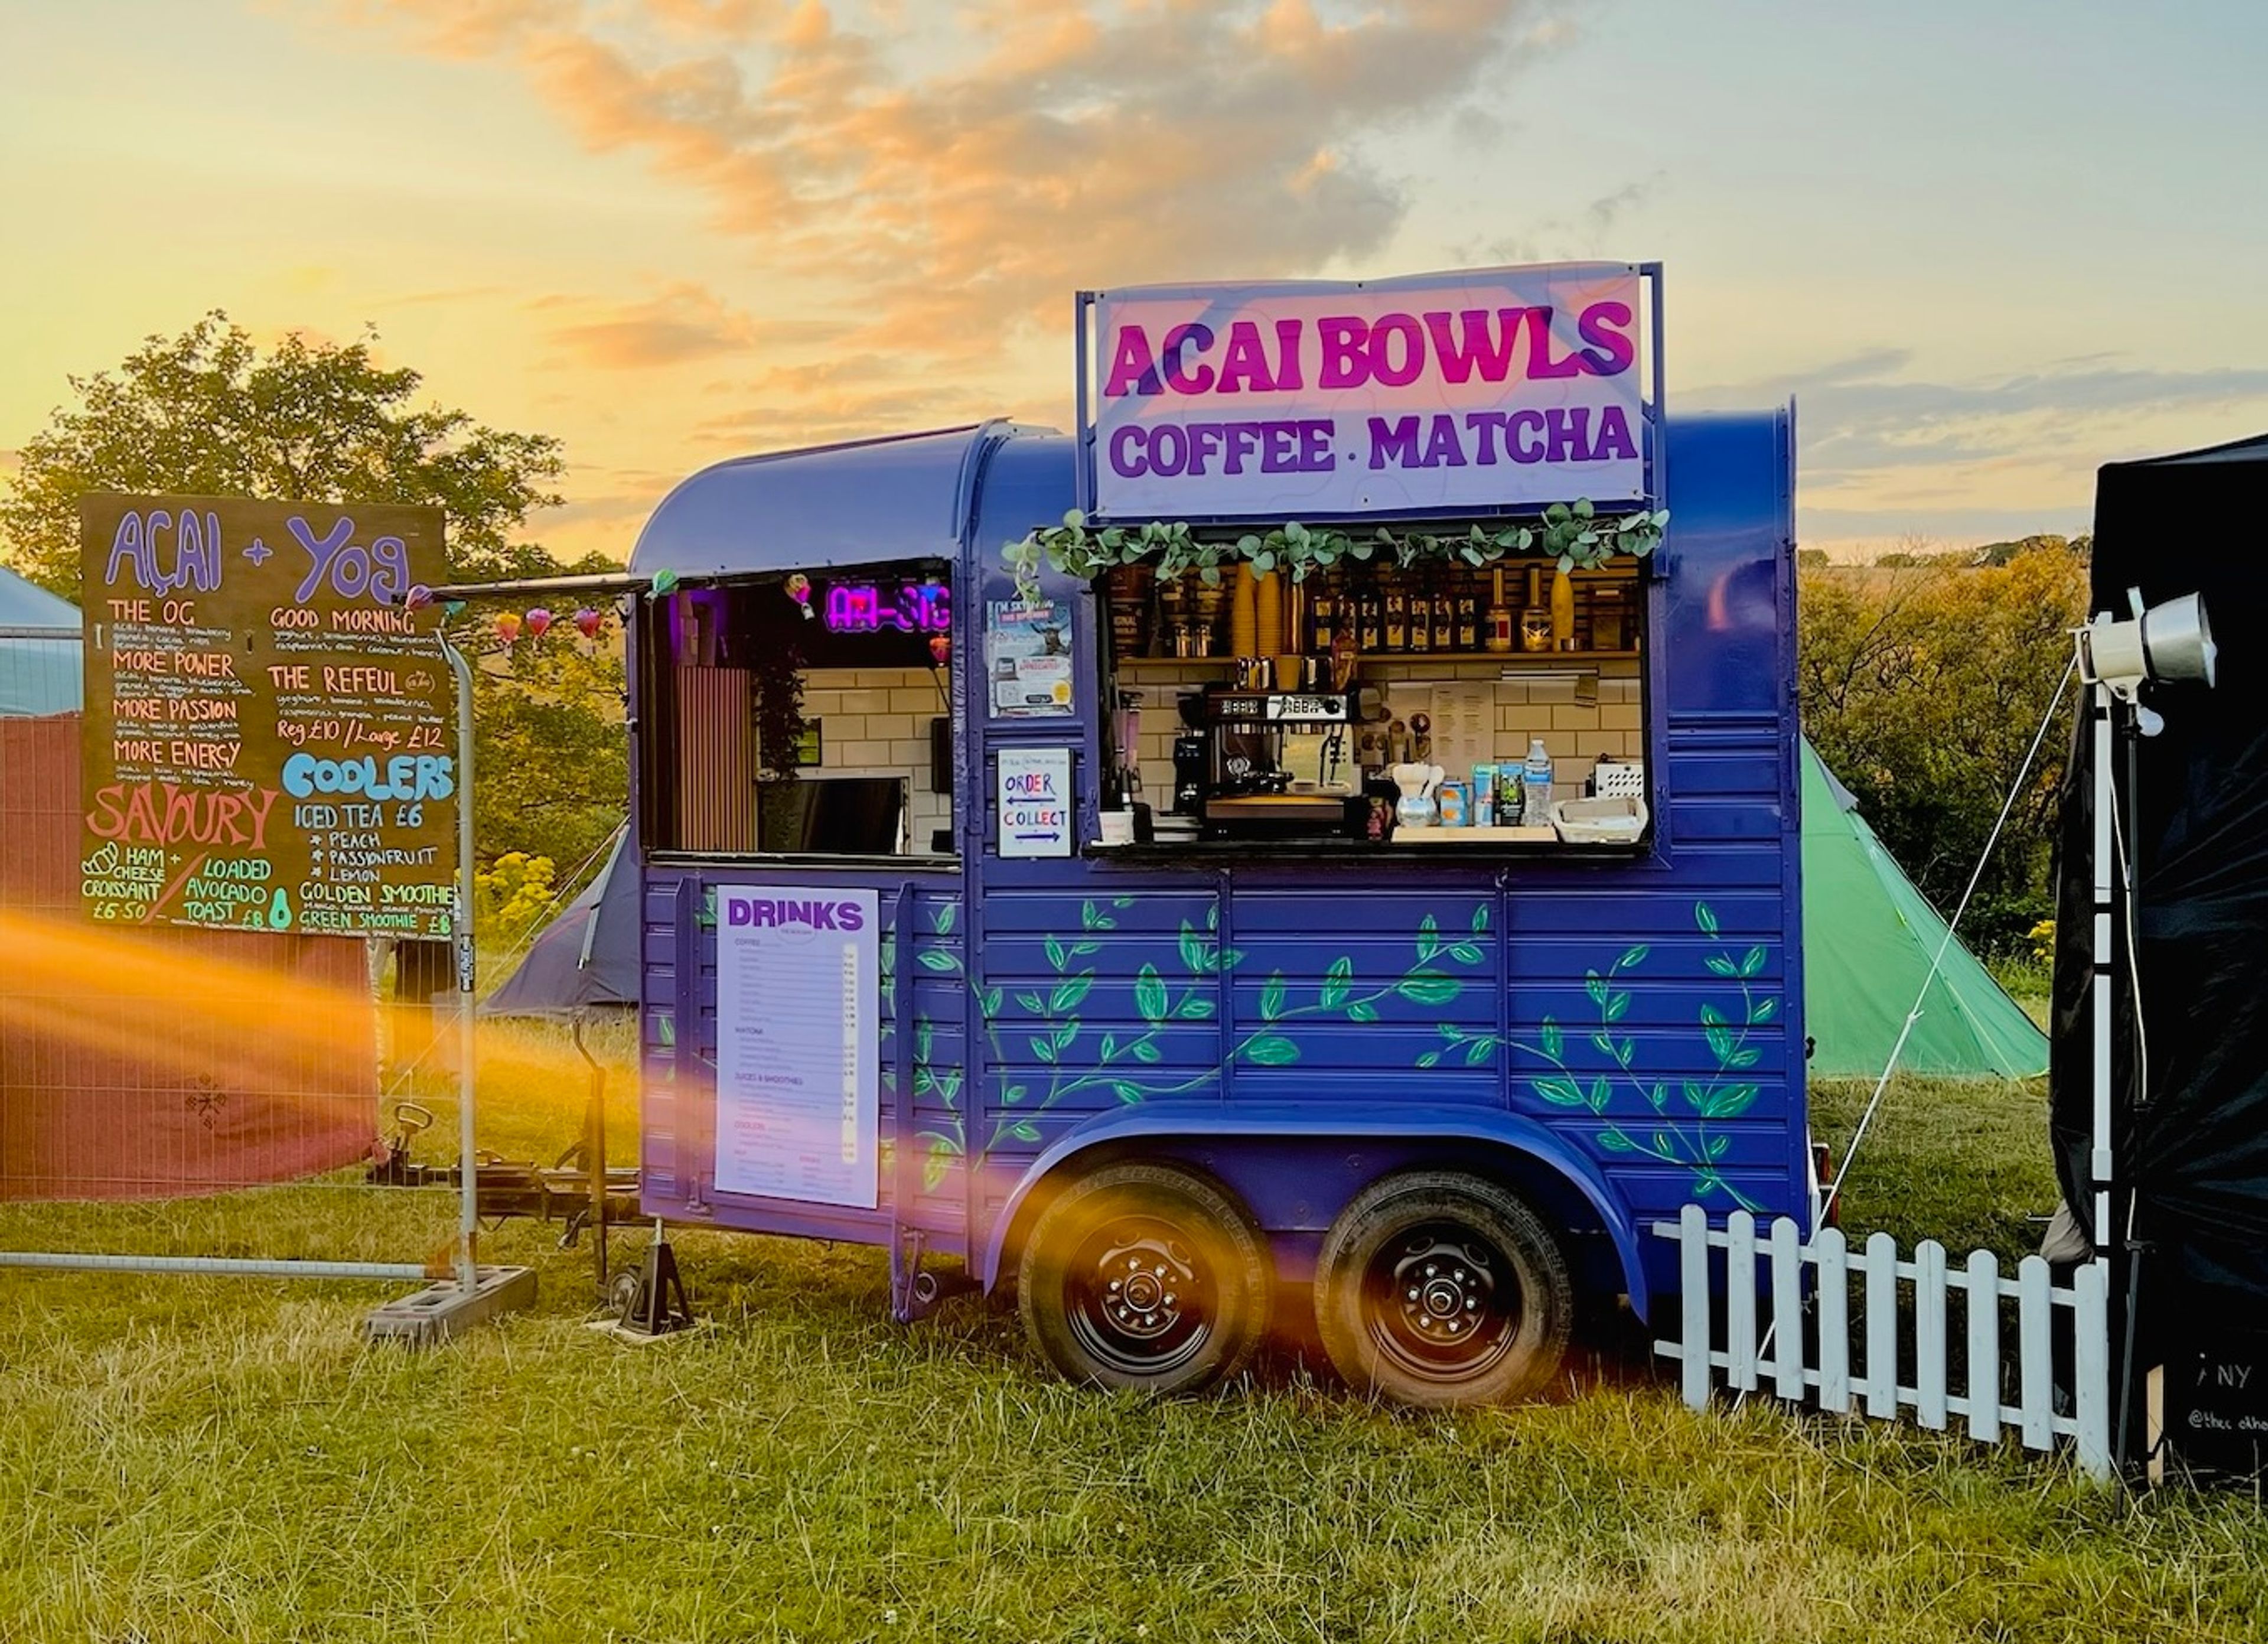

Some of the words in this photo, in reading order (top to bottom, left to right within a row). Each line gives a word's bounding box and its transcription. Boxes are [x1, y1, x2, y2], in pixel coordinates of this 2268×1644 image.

[1104, 320, 1303, 396] ACAI
[1318, 302, 1634, 389] BOWLS
[1109, 420, 1335, 478] COFFEE
[1368, 406, 1638, 470] MATCHA
[107, 599, 151, 621] THE
[163, 600, 195, 625] OG
[270, 607, 320, 629] GOOD
[331, 610, 415, 634] MORNING
[113, 651, 168, 673] MORE
[175, 653, 235, 677] POWER
[267, 666, 310, 689] THE
[323, 666, 405, 695] REFEUL
[113, 699, 162, 720] MORE
[168, 699, 237, 721] PASSION
[278, 720, 306, 746] Reg
[308, 720, 340, 740] £10
[406, 725, 445, 749] £12
[113, 741, 164, 763] MORE
[171, 741, 242, 769] ENERGY
[282, 752, 455, 800] COOLERS
[1005, 773, 1057, 795] ORDER
[86, 782, 279, 851] SAVOURY
[295, 804, 338, 829] ICED
[341, 804, 384, 828] TEA
[395, 803, 423, 828] £6
[1004, 810, 1067, 826] COLLECT
[329, 831, 382, 848] PEACH
[126, 847, 165, 867] HAM
[203, 858, 272, 880] LOADED
[329, 847, 438, 866] PASSIONFRUIT
[112, 865, 166, 883] CHEESE
[330, 868, 380, 883] LEMON
[82, 880, 162, 902] CROISSANT
[185, 878, 268, 904] AVOCADO
[299, 881, 372, 904] GOLDEN
[379, 885, 454, 905] SMOOTHIE
[183, 901, 237, 922] TOAST
[242, 910, 265, 928] £8
[299, 910, 352, 929] GREEN
[359, 913, 419, 929] SMOOTHIE
[428, 913, 451, 934] £8
[728, 898, 864, 931] DRINKS
